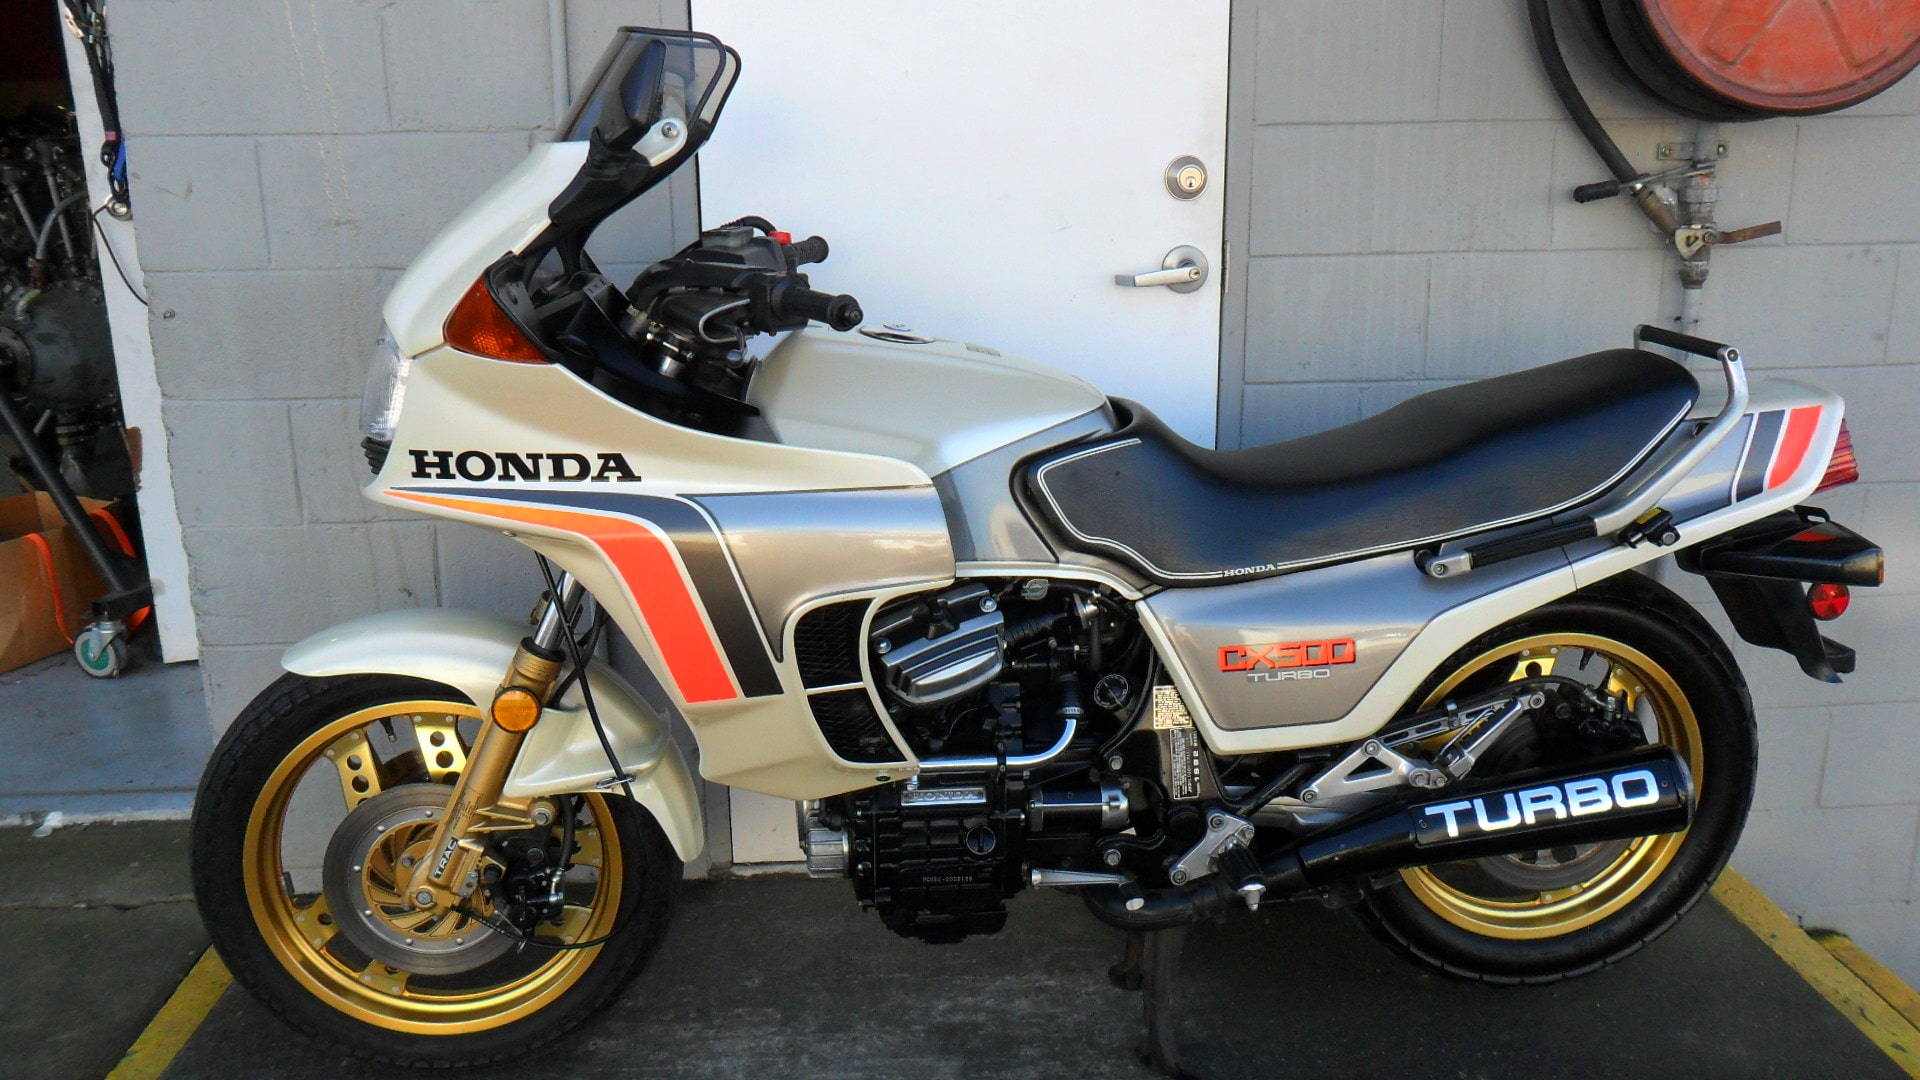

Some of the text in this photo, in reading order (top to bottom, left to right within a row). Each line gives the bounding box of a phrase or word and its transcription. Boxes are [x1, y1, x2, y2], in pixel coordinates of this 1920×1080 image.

[408, 449, 642, 482] HONDA
[1223, 563, 1277, 577] HONDA
[1218, 637, 1356, 672] CX500
[1248, 668, 1330, 682] TURBO
[909, 790, 979, 801] HONDA
[1424, 769, 1660, 837] TURBO
[434, 837, 458, 877] TRAC
